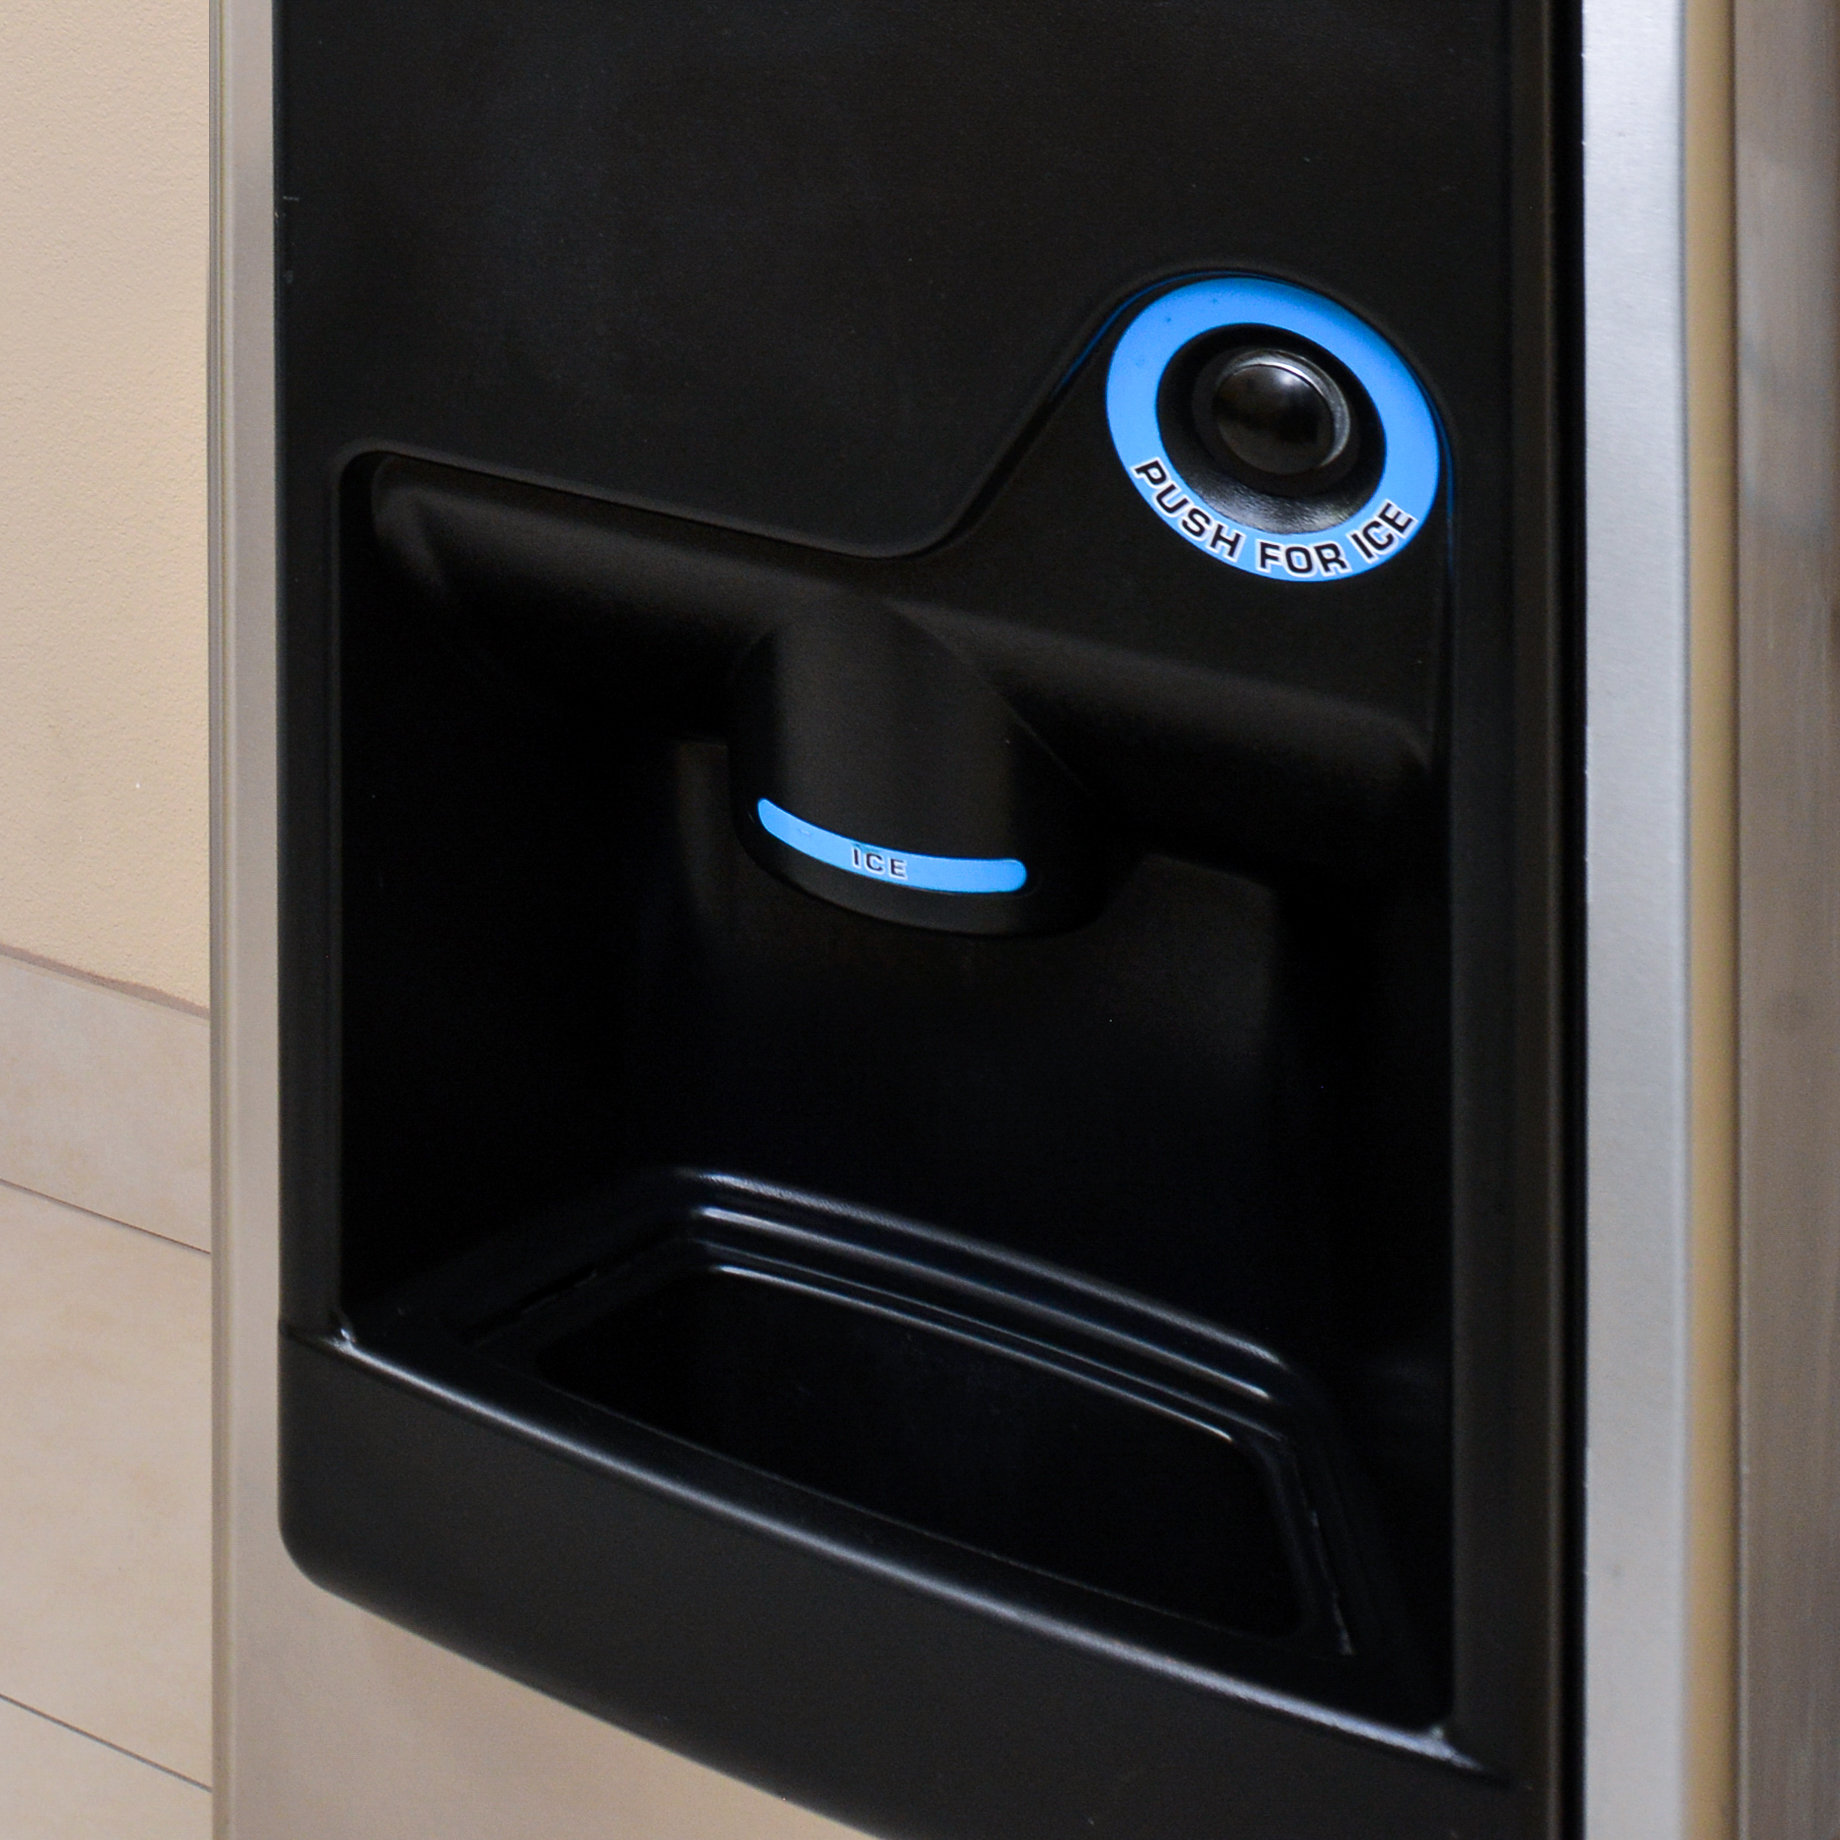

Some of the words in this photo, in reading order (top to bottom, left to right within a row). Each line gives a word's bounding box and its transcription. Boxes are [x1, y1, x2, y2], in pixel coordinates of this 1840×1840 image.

[1133, 458, 1244, 561] PUSH
[1257, 541, 1351, 576] FOR
[1350, 501, 1417, 562] ICE
[852, 846, 908, 880] ICE
